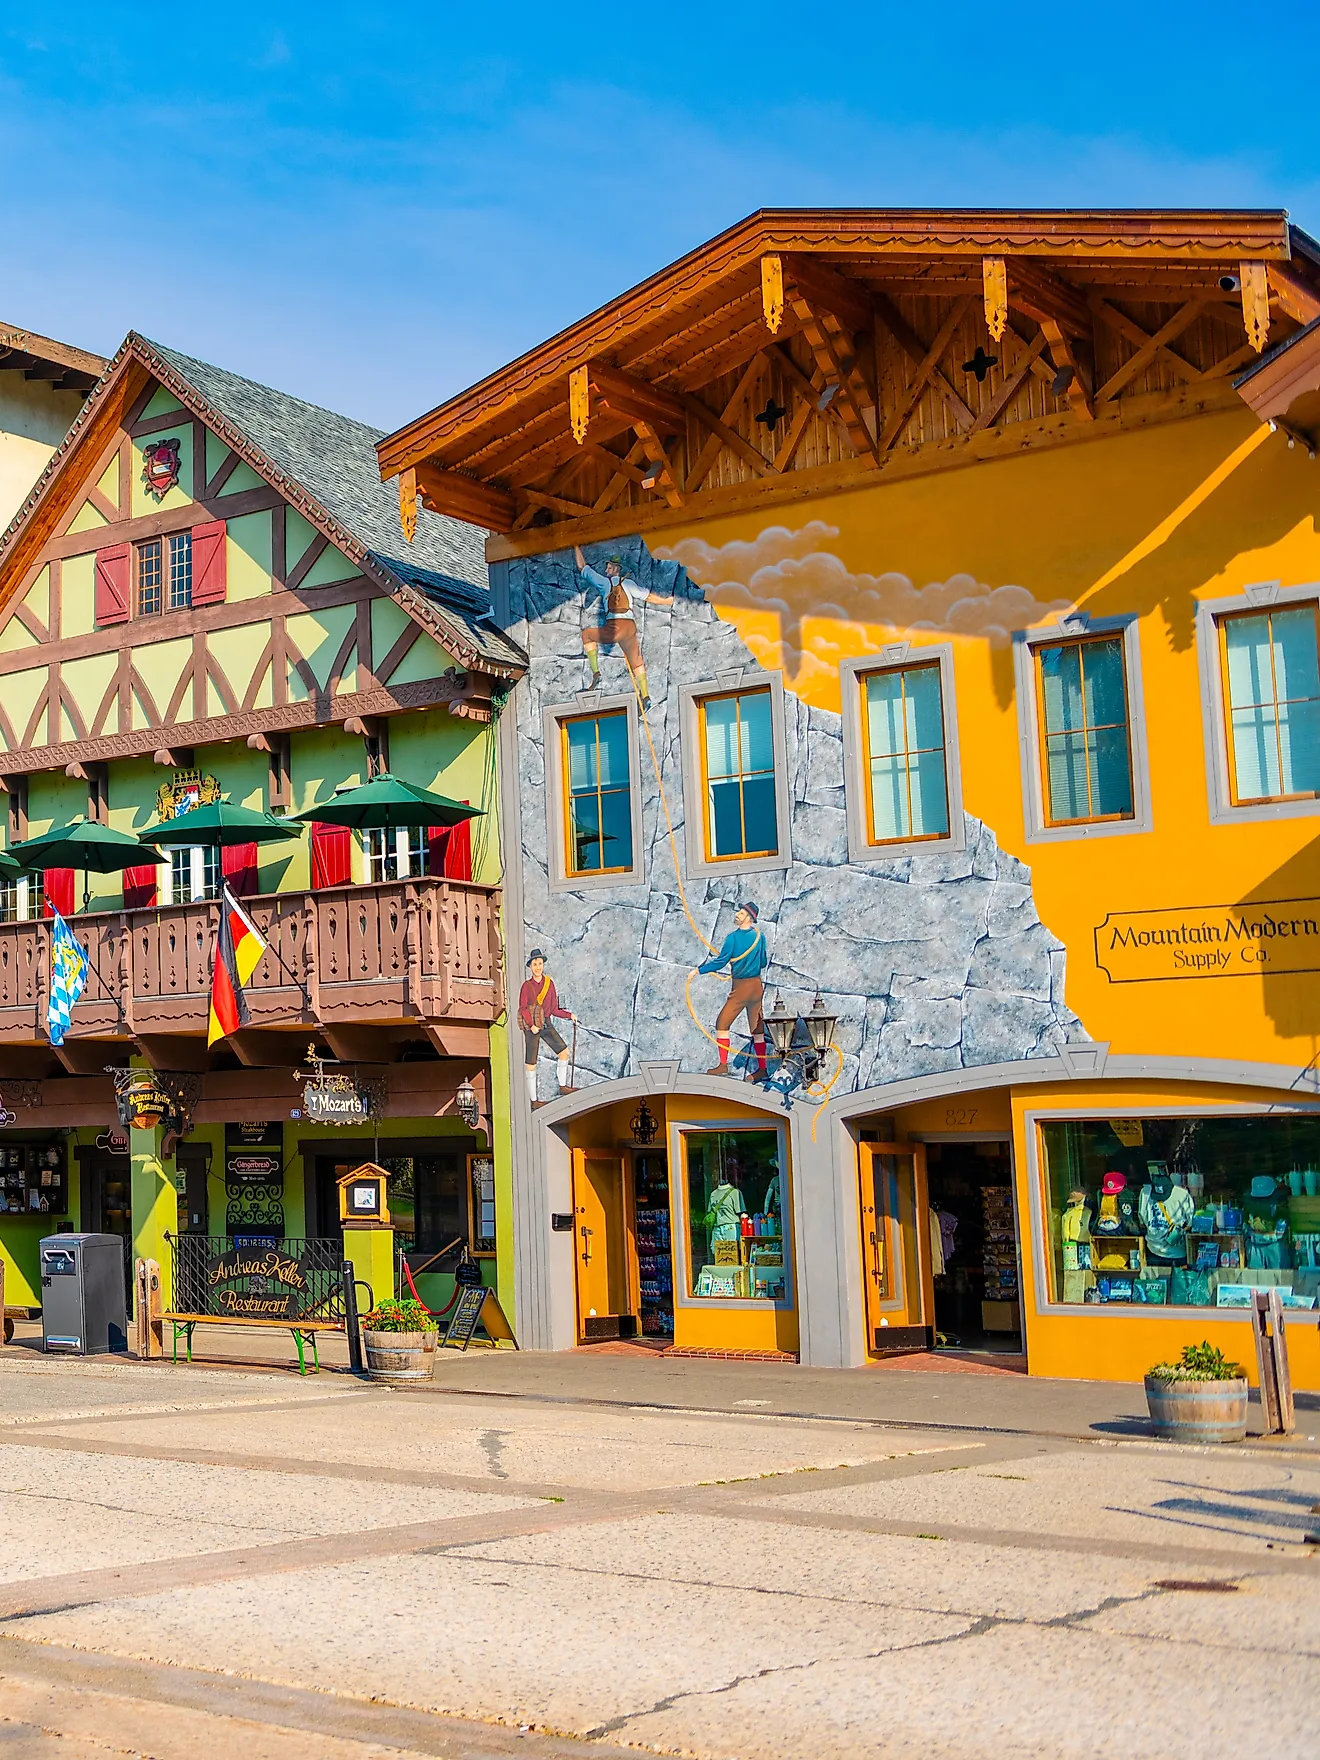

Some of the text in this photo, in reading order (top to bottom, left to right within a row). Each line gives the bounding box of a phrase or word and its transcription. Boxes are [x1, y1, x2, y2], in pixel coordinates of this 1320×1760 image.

[1110, 914, 1319, 949] Mountain Modern
[1173, 946, 1271, 970] Supply Co.
[129, 1091, 171, 1105] Andreas Keller
[136, 1102, 164, 1114] Restaurant
[318, 1094, 362, 1114] Mozart's
[945, 1109, 978, 1126] 827
[209, 1253, 306, 1288] Andreas Keller
[220, 1290, 289, 1313] Restaurant
